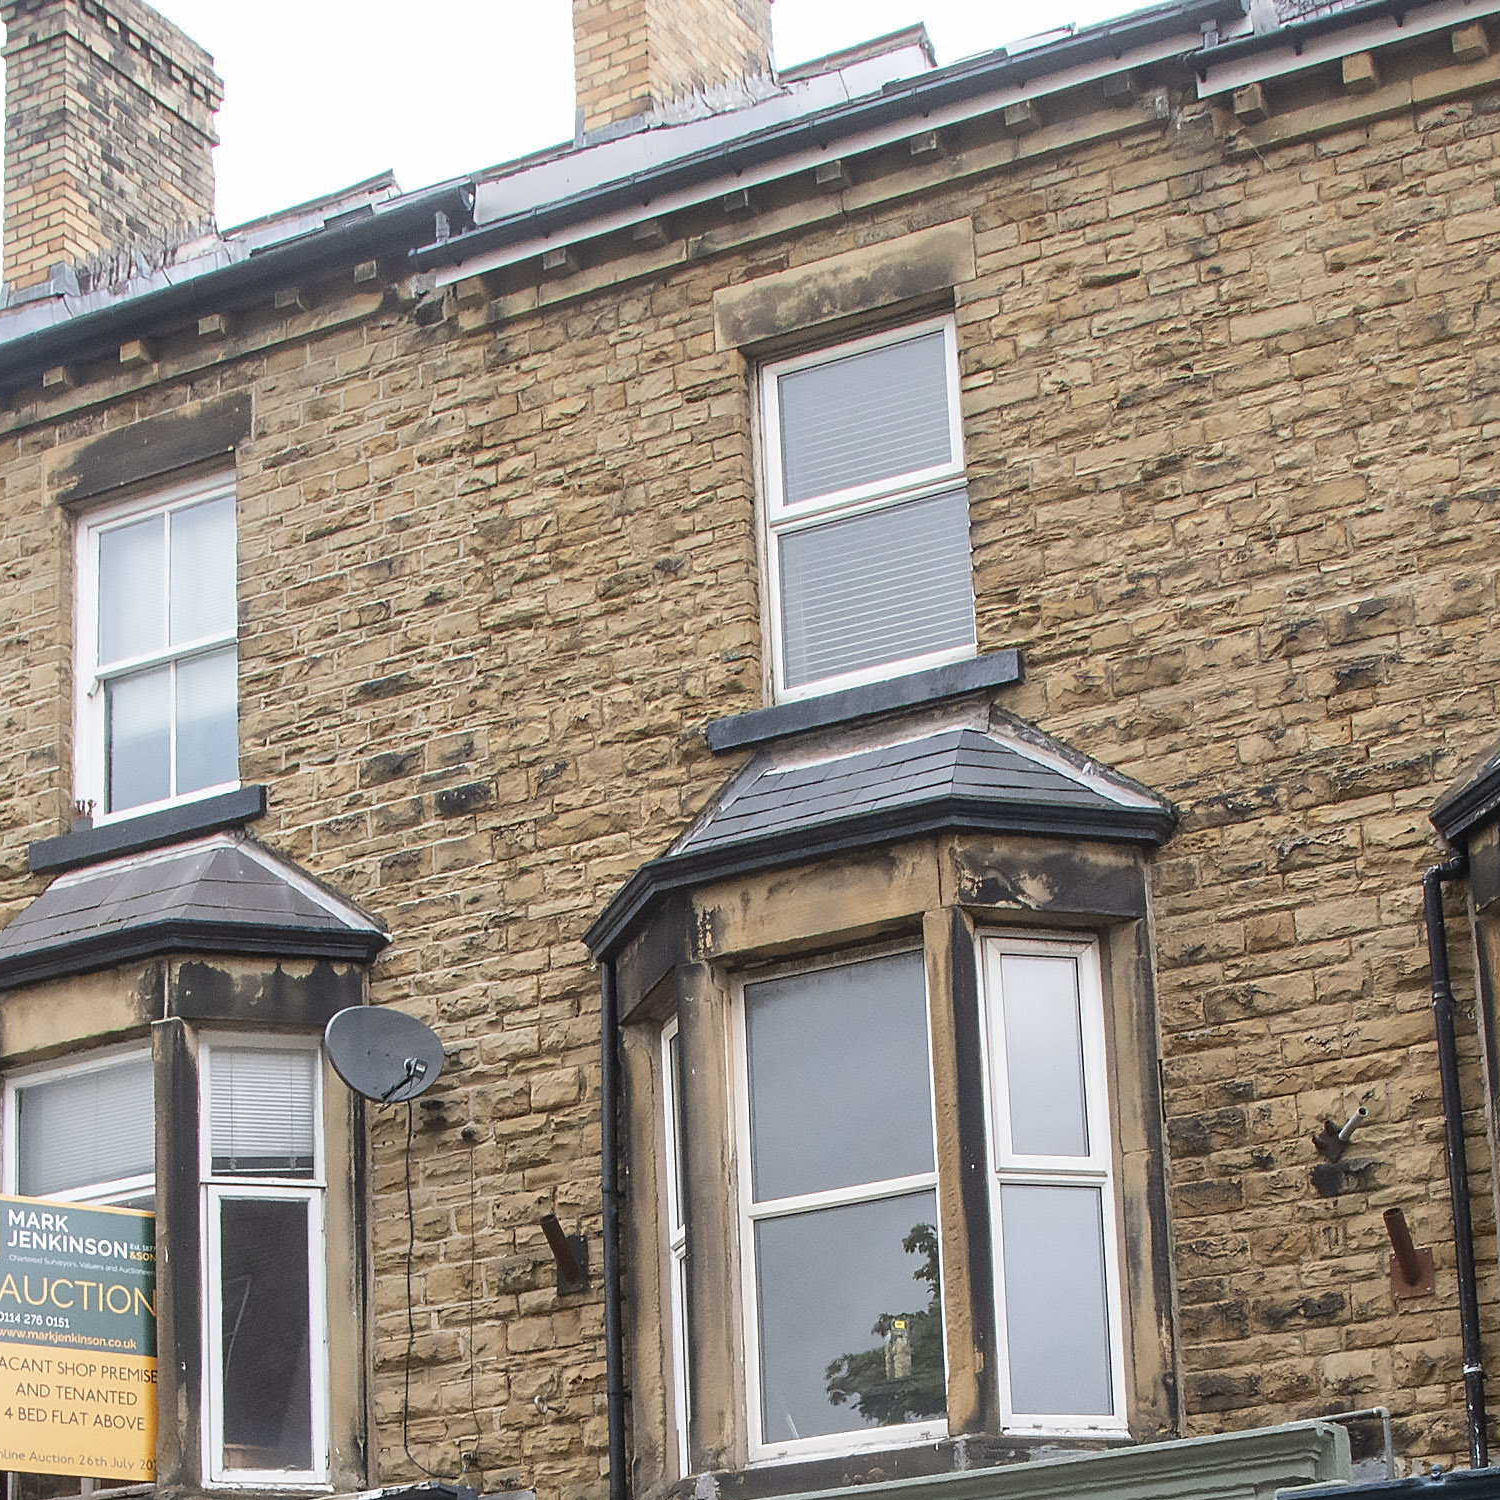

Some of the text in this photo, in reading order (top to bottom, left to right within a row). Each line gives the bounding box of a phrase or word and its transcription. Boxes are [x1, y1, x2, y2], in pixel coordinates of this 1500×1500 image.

[8, 1209, 69, 1233] MARK
[7, 1230, 128, 1260] JENKINSON
[8, 1253, 43, 1266] Chartered
[105, 1263, 117, 1272] and
[24, 1313, 43, 1327] 276
[45, 1315, 70, 1329] 0151
[57, 1361, 97, 1378] SHOP
[15, 1382, 138, 1406] AND TENANTED
[4, 1407, 146, 1432] 4 BED FLAT ABOVE
[28, 1450, 75, 1466] Auction
[79, 1454, 107, 1469] 26th
[110, 1456, 135, 1471] July
